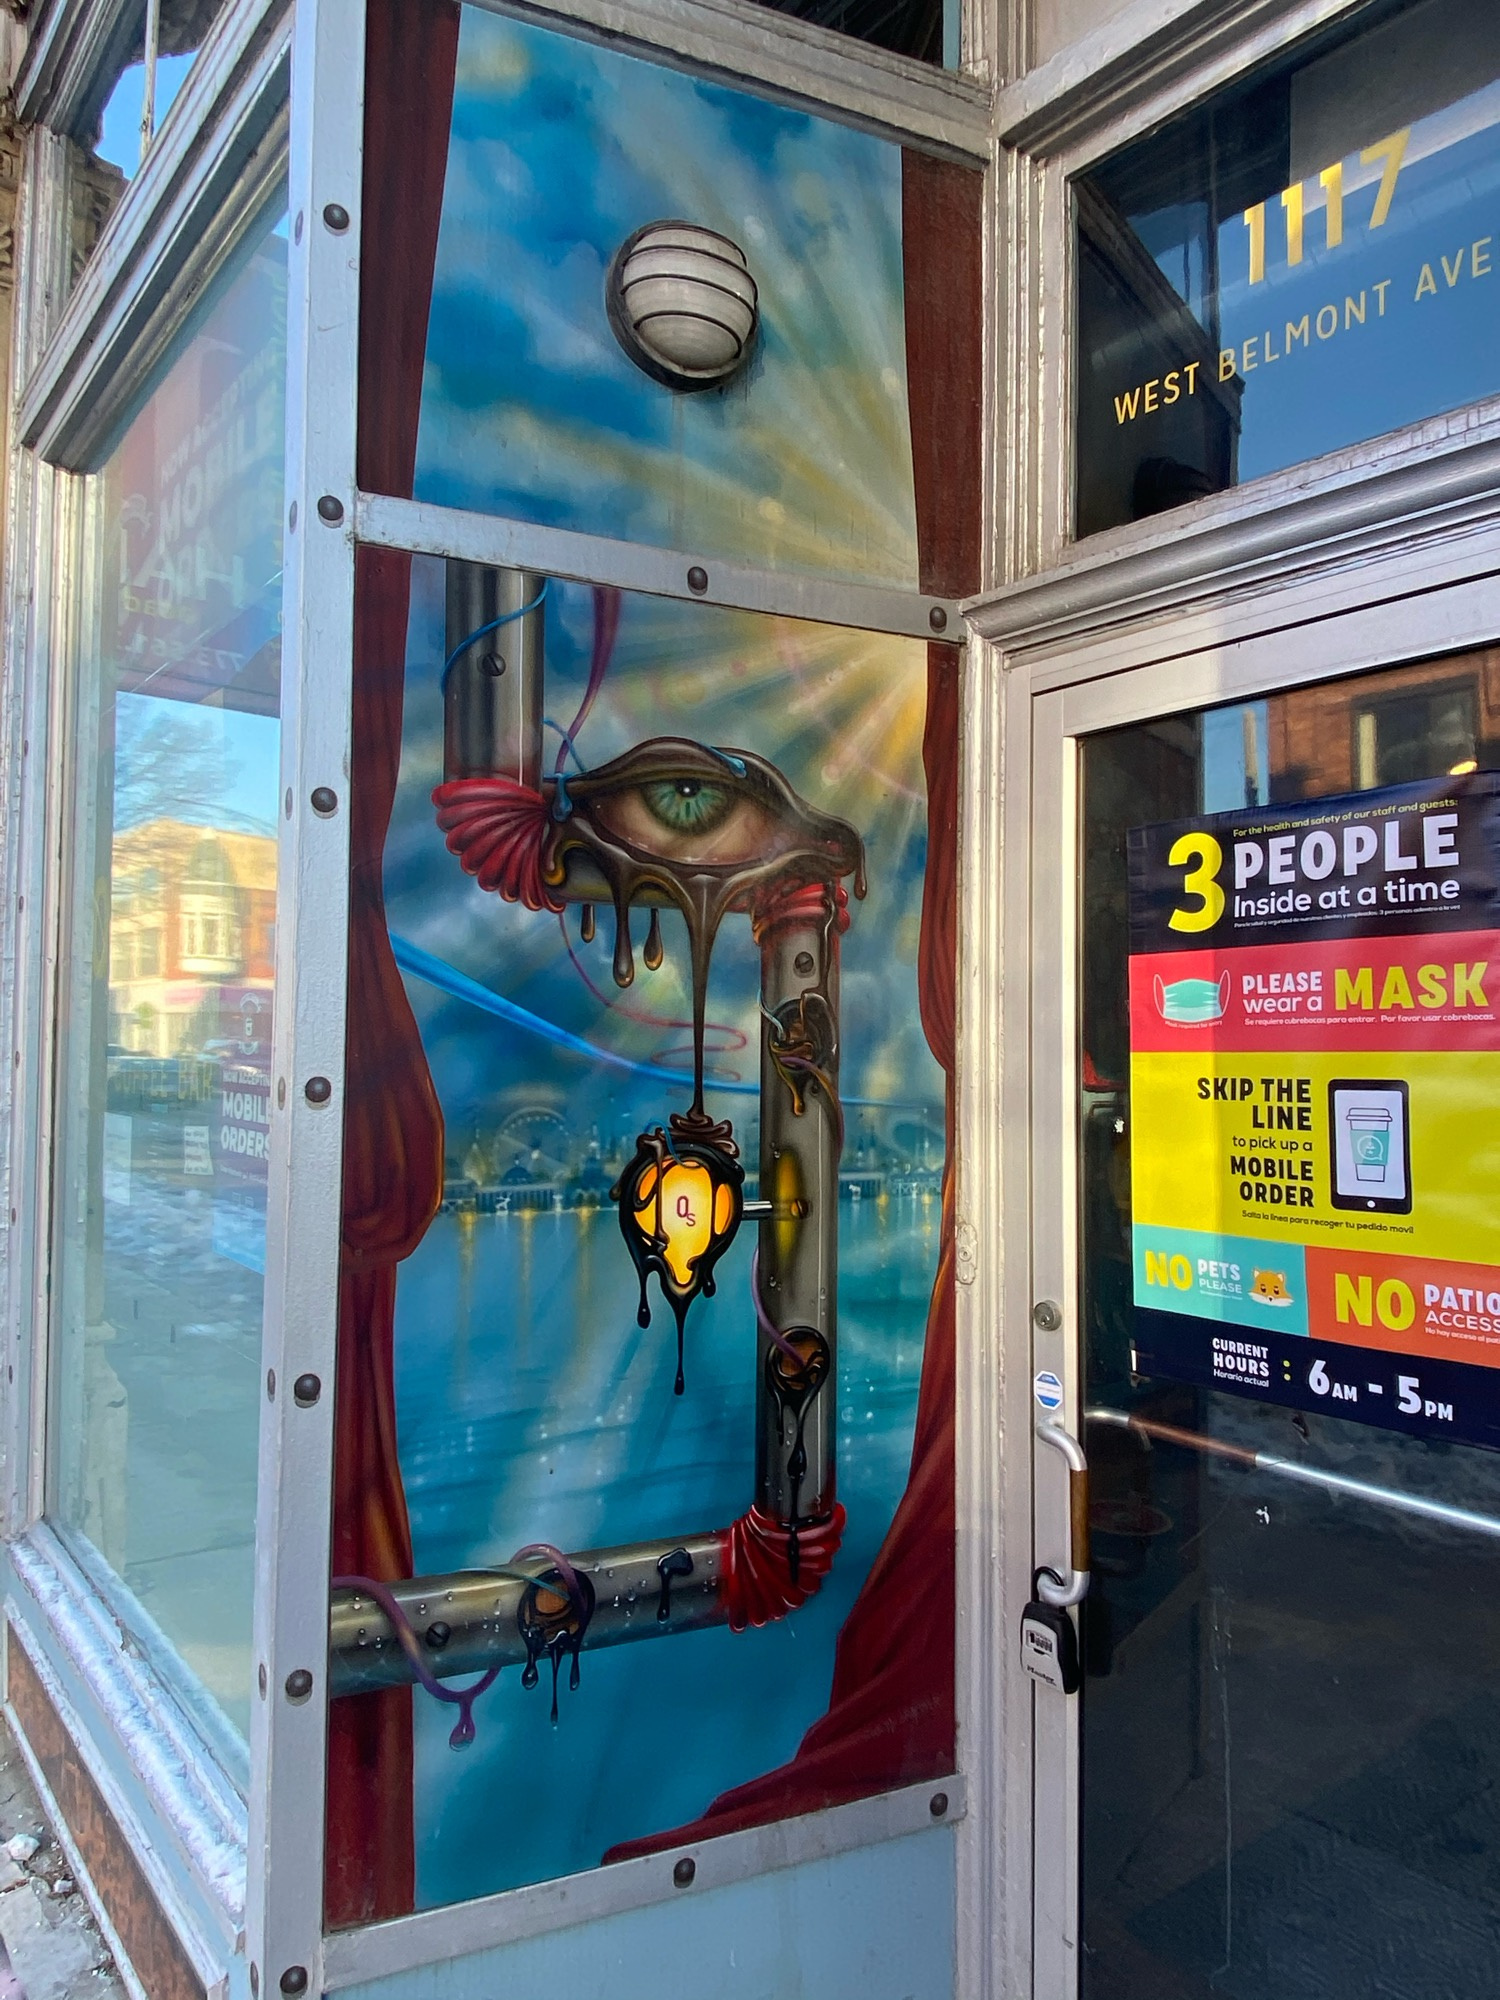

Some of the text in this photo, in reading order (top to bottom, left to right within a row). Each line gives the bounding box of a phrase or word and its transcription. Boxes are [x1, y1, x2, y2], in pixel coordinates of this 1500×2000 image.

[1244, 127, 1411, 285] 1117
[1114, 236, 1492, 424] WEST BELMONT AVE
[1233, 828, 1246, 837] For
[1248, 826, 1262, 835] the
[1263, 821, 1290, 833] health
[1291, 818, 1310, 828] and
[1310, 814, 1341, 826] safety
[1342, 811, 1353, 820] of
[1354, 810, 1370, 819] our
[1372, 805, 1397, 817] staff
[1398, 802, 1418, 812] and
[1168, 813, 1459, 933] 3 PEOPLE
[1234, 877, 1460, 918] Inside at a time
[1242, 971, 1322, 995] PLEASE
[1334, 961, 1489, 1010] MASK
[1243, 996, 1322, 1013] wear a
[1254, 1018, 1283, 1026] requiere
[1326, 1016, 1347, 1024] para
[1380, 1014, 1396, 1022] Por
[1398, 1014, 1421, 1022] favor
[1197, 1077, 1311, 1103] SKIP THE
[1252, 1105, 1312, 1131] LINE
[1232, 1135, 1312, 1154] to pick up a
[1230, 1155, 1313, 1181] MOBILE
[1240, 1181, 1314, 1207] ORDER
[1242, 1210, 1261, 1219] Salta
[1262, 1212, 1269, 1220] la
[1289, 1216, 1309, 1225] para
[1310, 1219, 1343, 1229] recoger
[1345, 1221, 1355, 1229] tu
[1356, 1222, 1388, 1232] pedido
[1145, 1249, 1240, 1291] NO PETS
[1199, 1278, 1242, 1294] PLEASE
[1335, 1272, 1500, 1331] NO PATIO
[1437, 1328, 1450, 1338] hay
[1212, 1337, 1268, 1359] CURRENT
[1213, 1352, 1269, 1377] HOURS
[1213, 1369, 1269, 1388] Horario actual
